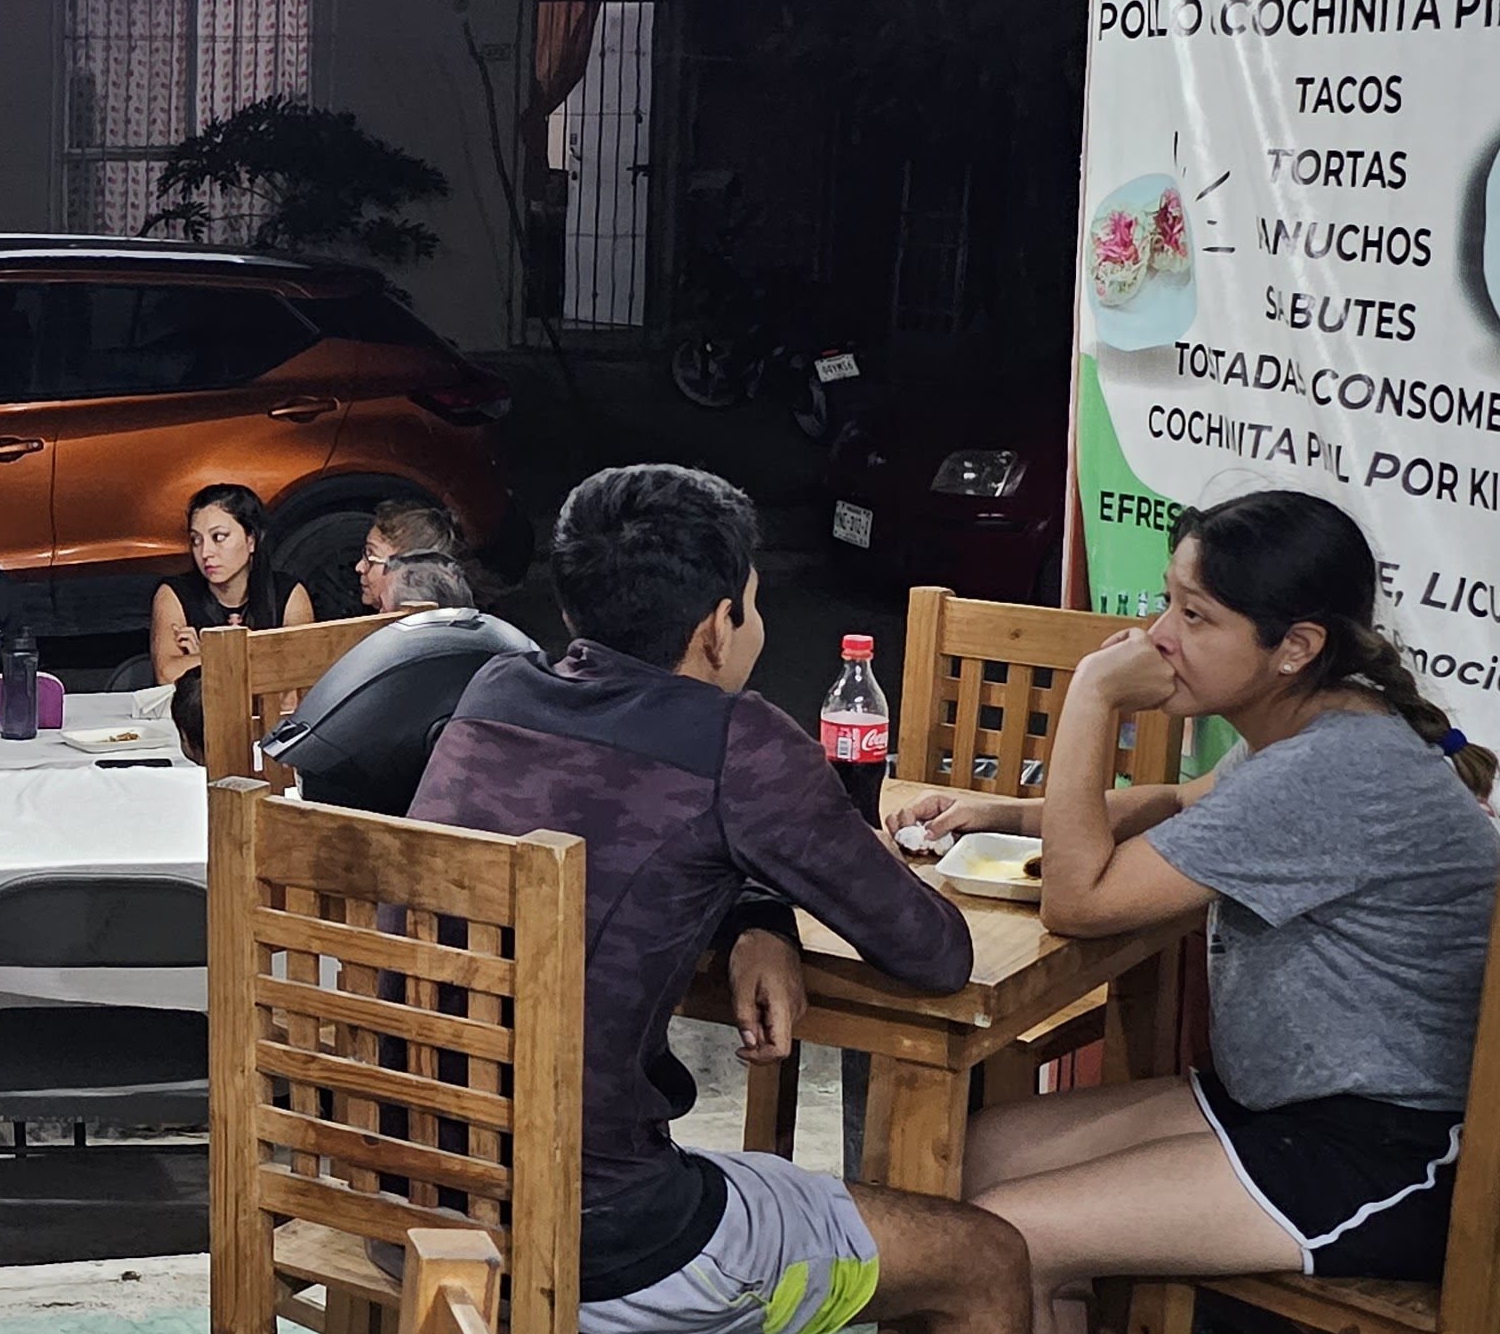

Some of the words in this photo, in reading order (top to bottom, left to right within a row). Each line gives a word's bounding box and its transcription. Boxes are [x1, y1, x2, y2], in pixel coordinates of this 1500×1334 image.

[1295, 74, 1404, 114] TACOS
[1266, 148, 1408, 190] TORTAS
[1174, 341, 1307, 397] TOTADA
[1364, 451, 1459, 503] POR
